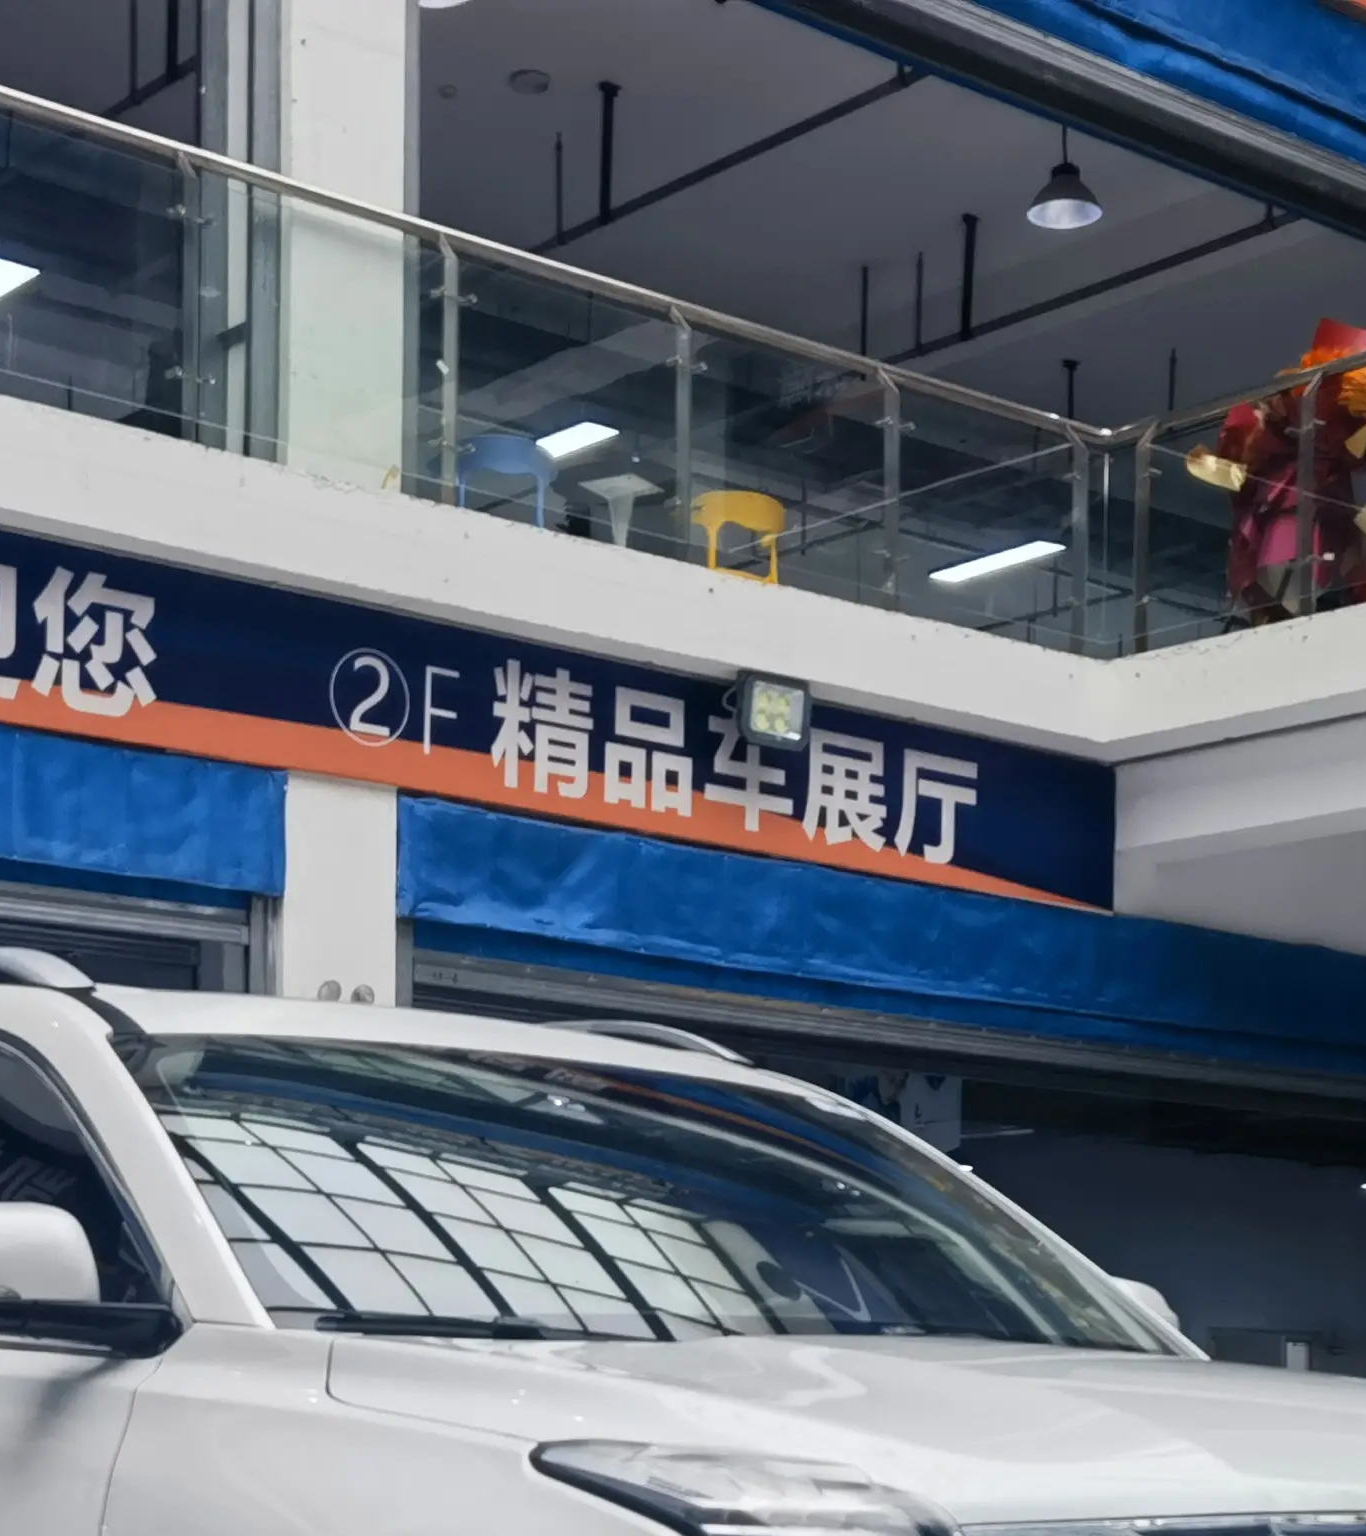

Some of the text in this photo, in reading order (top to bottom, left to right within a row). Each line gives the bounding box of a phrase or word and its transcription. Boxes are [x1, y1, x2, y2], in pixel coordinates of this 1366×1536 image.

[490, 658, 979, 865] 精品车展厅
